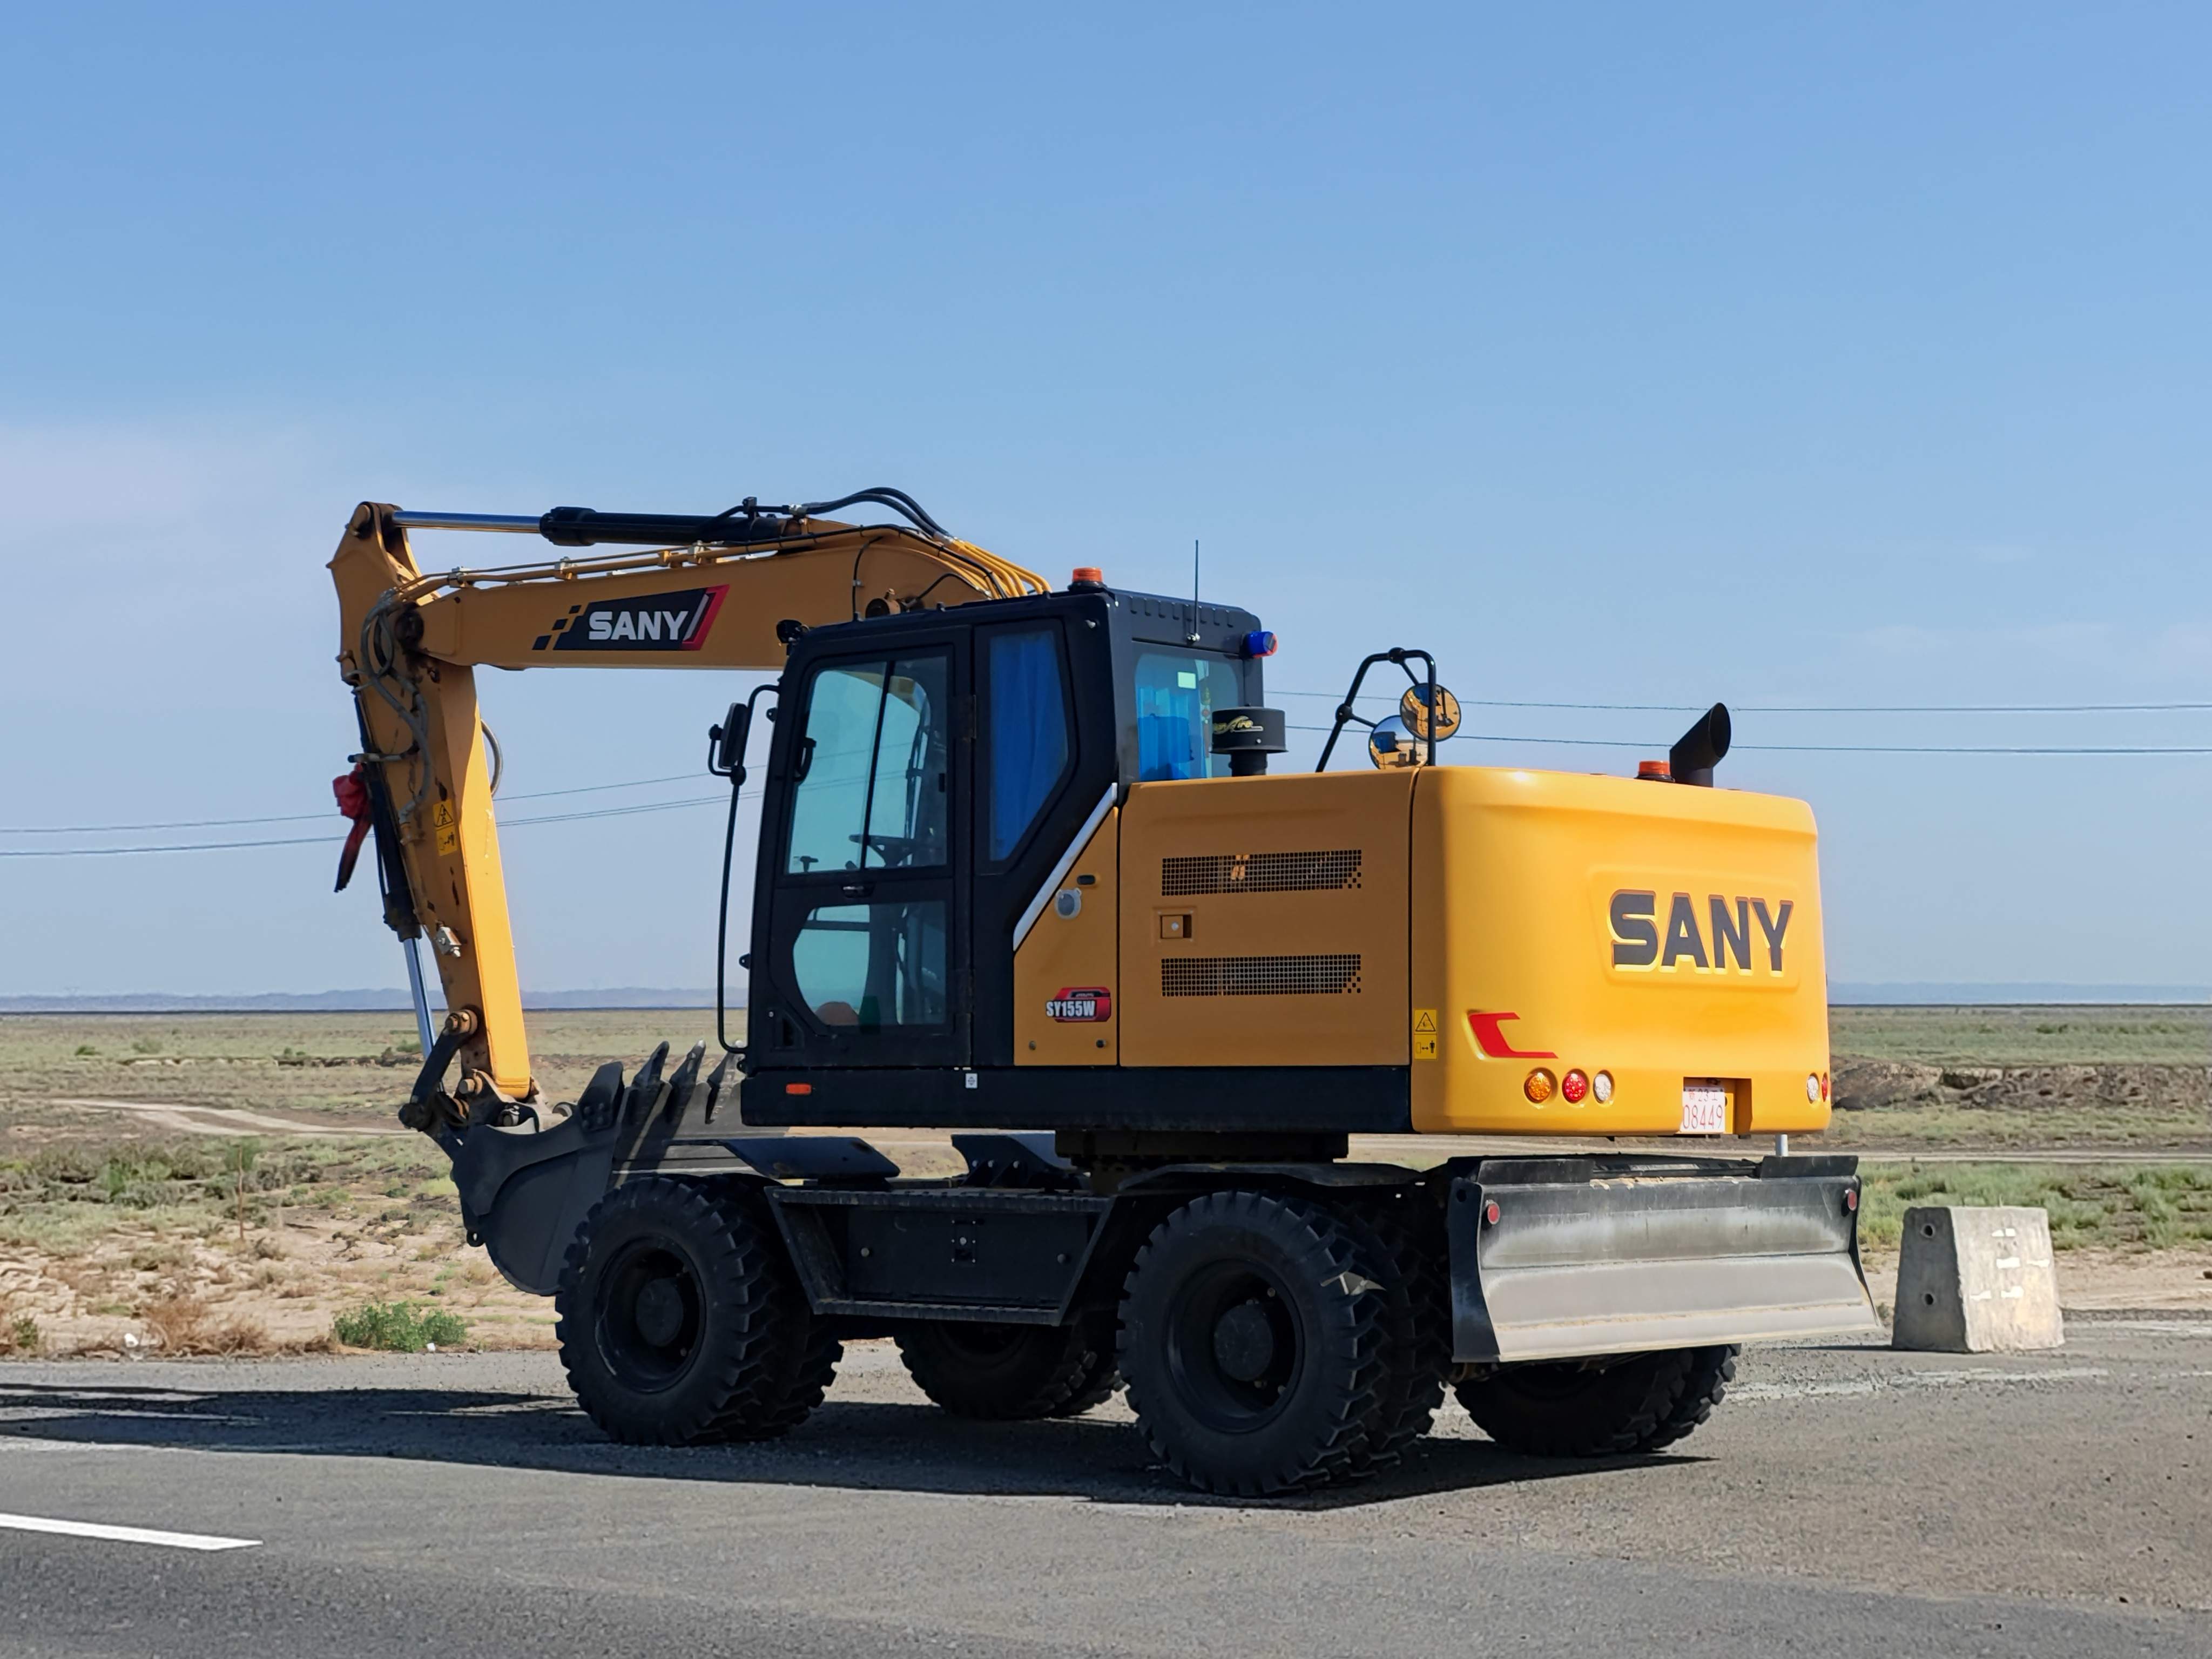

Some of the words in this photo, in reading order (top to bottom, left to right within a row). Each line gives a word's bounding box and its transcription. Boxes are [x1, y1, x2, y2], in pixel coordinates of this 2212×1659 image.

[589, 611, 689, 640] SANY
[1609, 889, 1794, 974] SANY
[1046, 1001, 1096, 1016] SY155W
[1683, 1104, 1723, 1129] 08449
